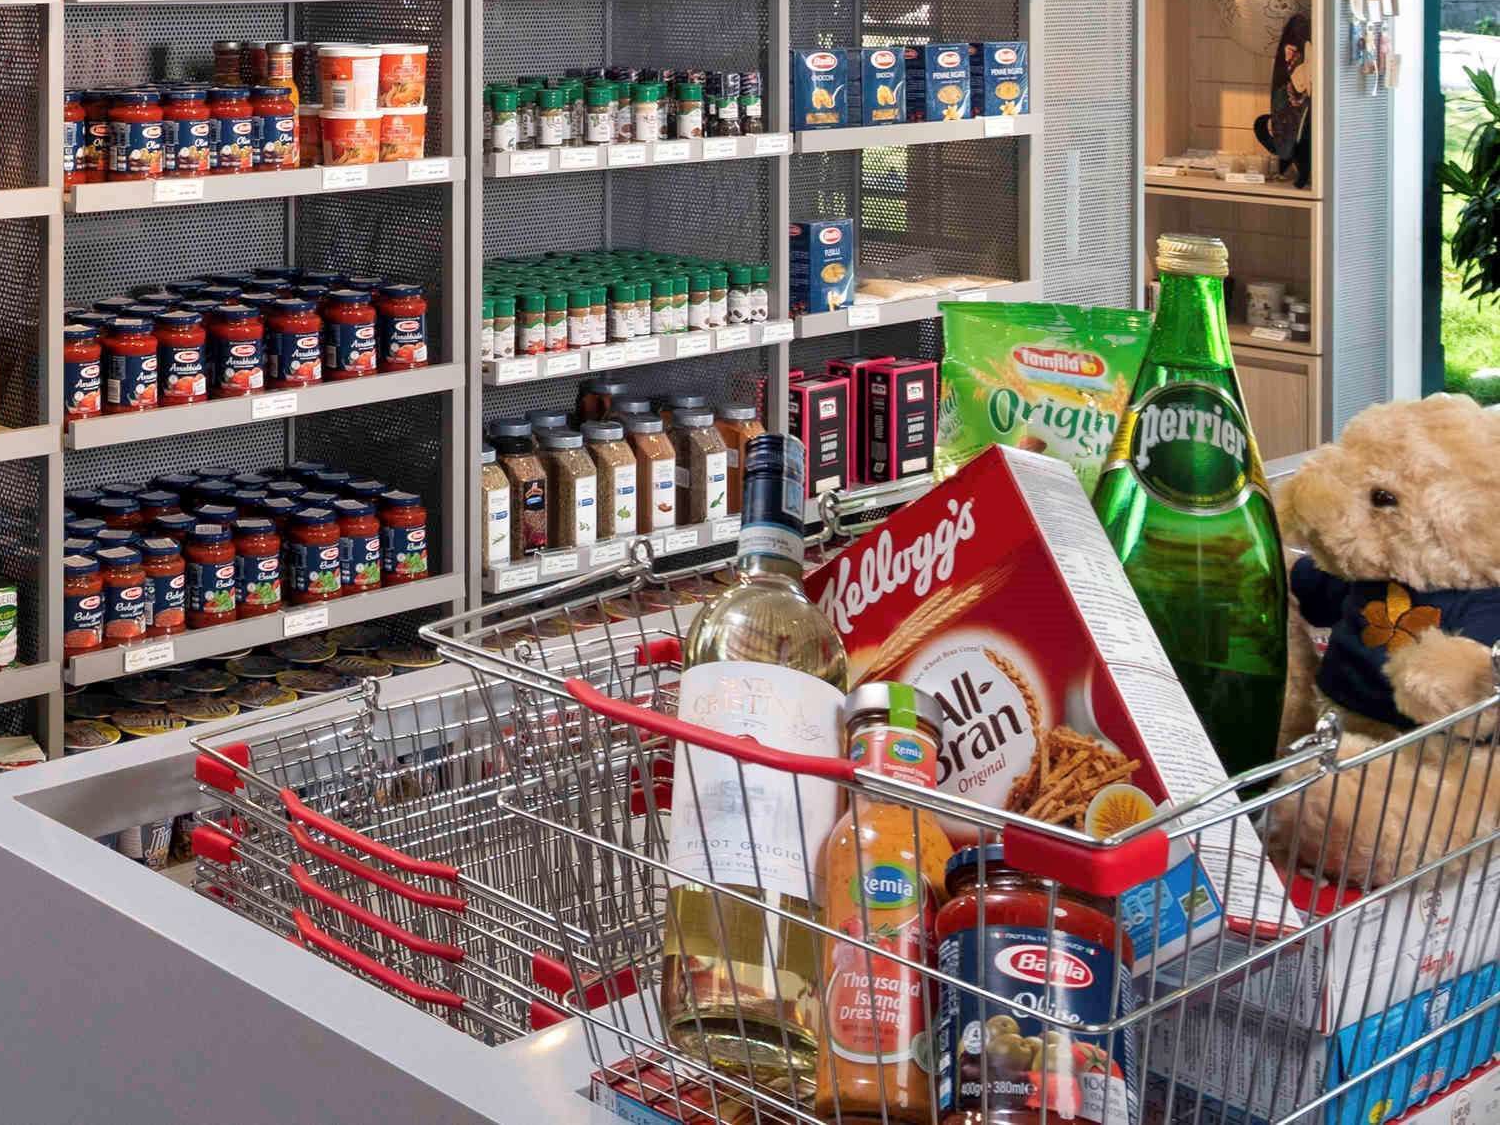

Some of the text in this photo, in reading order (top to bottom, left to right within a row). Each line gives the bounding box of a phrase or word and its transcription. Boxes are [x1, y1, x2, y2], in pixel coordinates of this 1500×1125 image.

[988, 387, 1116, 440] Origin
[818, 497, 976, 635] Kellogg's
[957, 753, 1007, 794] Original
[686, 839, 732, 850] PIOT
